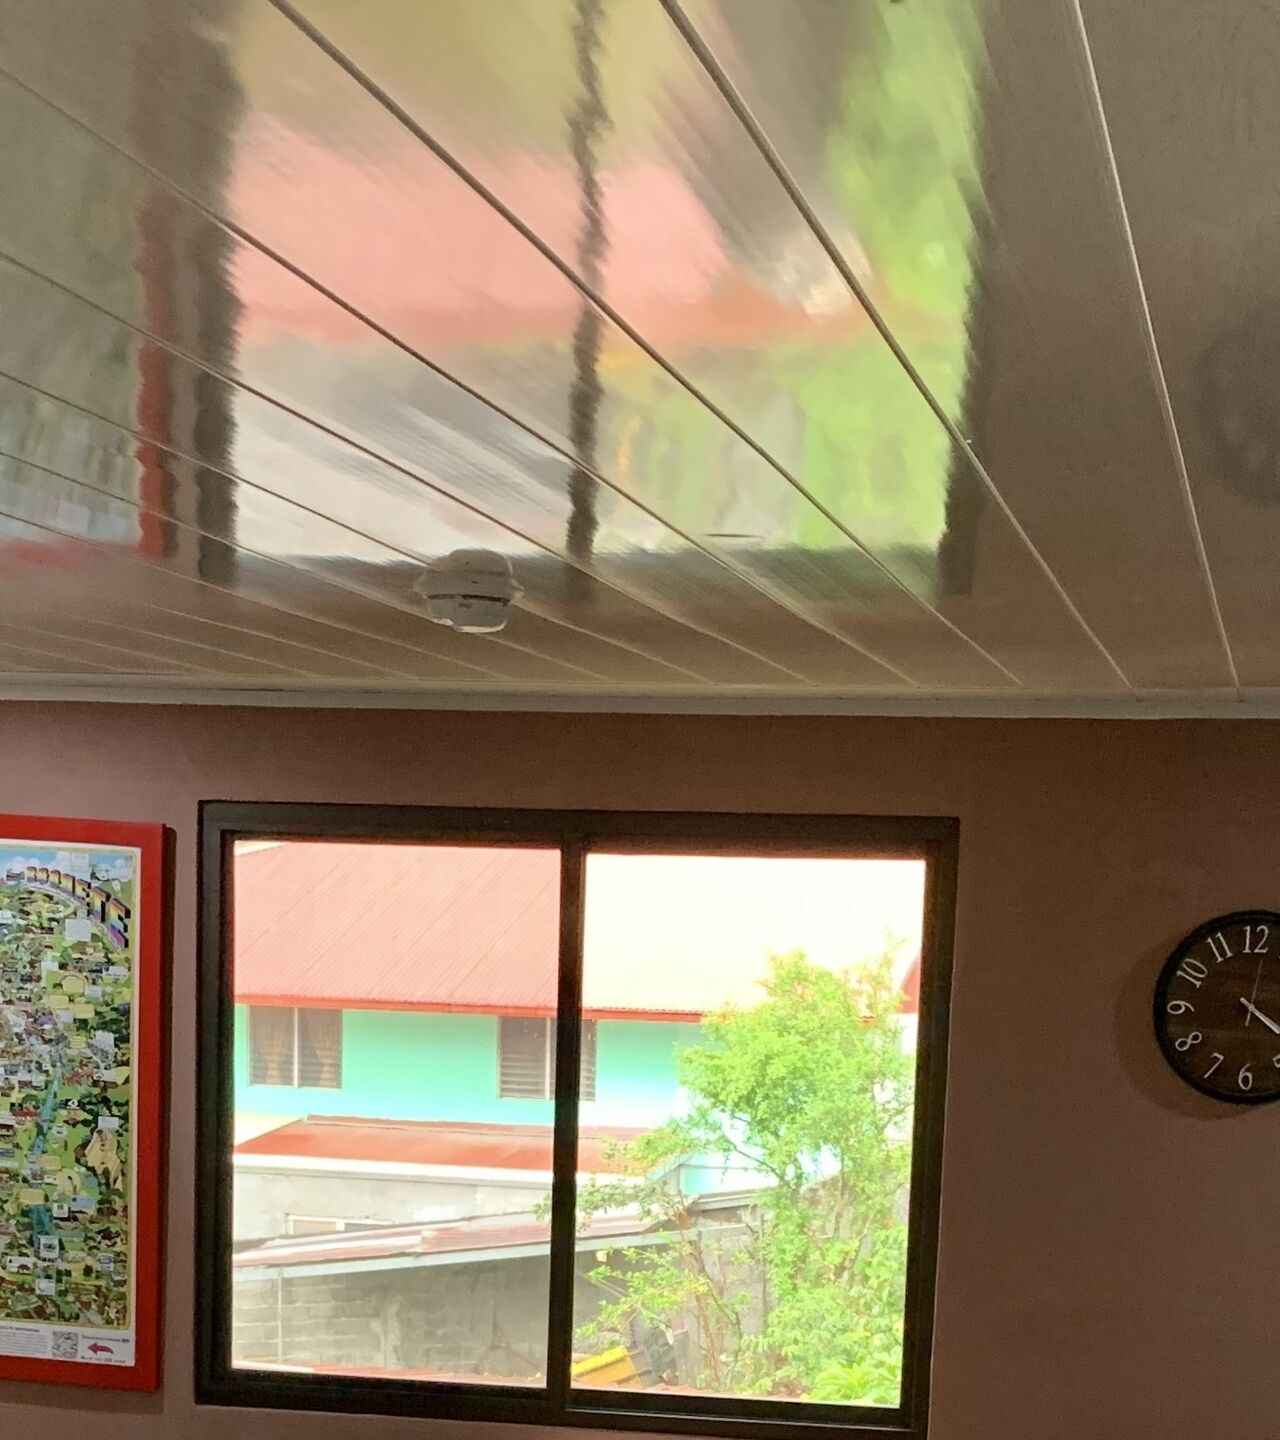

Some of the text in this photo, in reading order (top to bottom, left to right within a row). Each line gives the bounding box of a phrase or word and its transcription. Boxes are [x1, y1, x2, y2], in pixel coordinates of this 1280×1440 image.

[1206, 932, 1235, 963] 11
[1242, 925, 1269, 954] 12
[1176, 958, 1209, 989] 10
[1166, 1000, 1195, 1015] 9
[1175, 1031, 1202, 1052] 8
[1203, 1052, 1225, 1079] 7
[1238, 1063, 1253, 1091] 6
